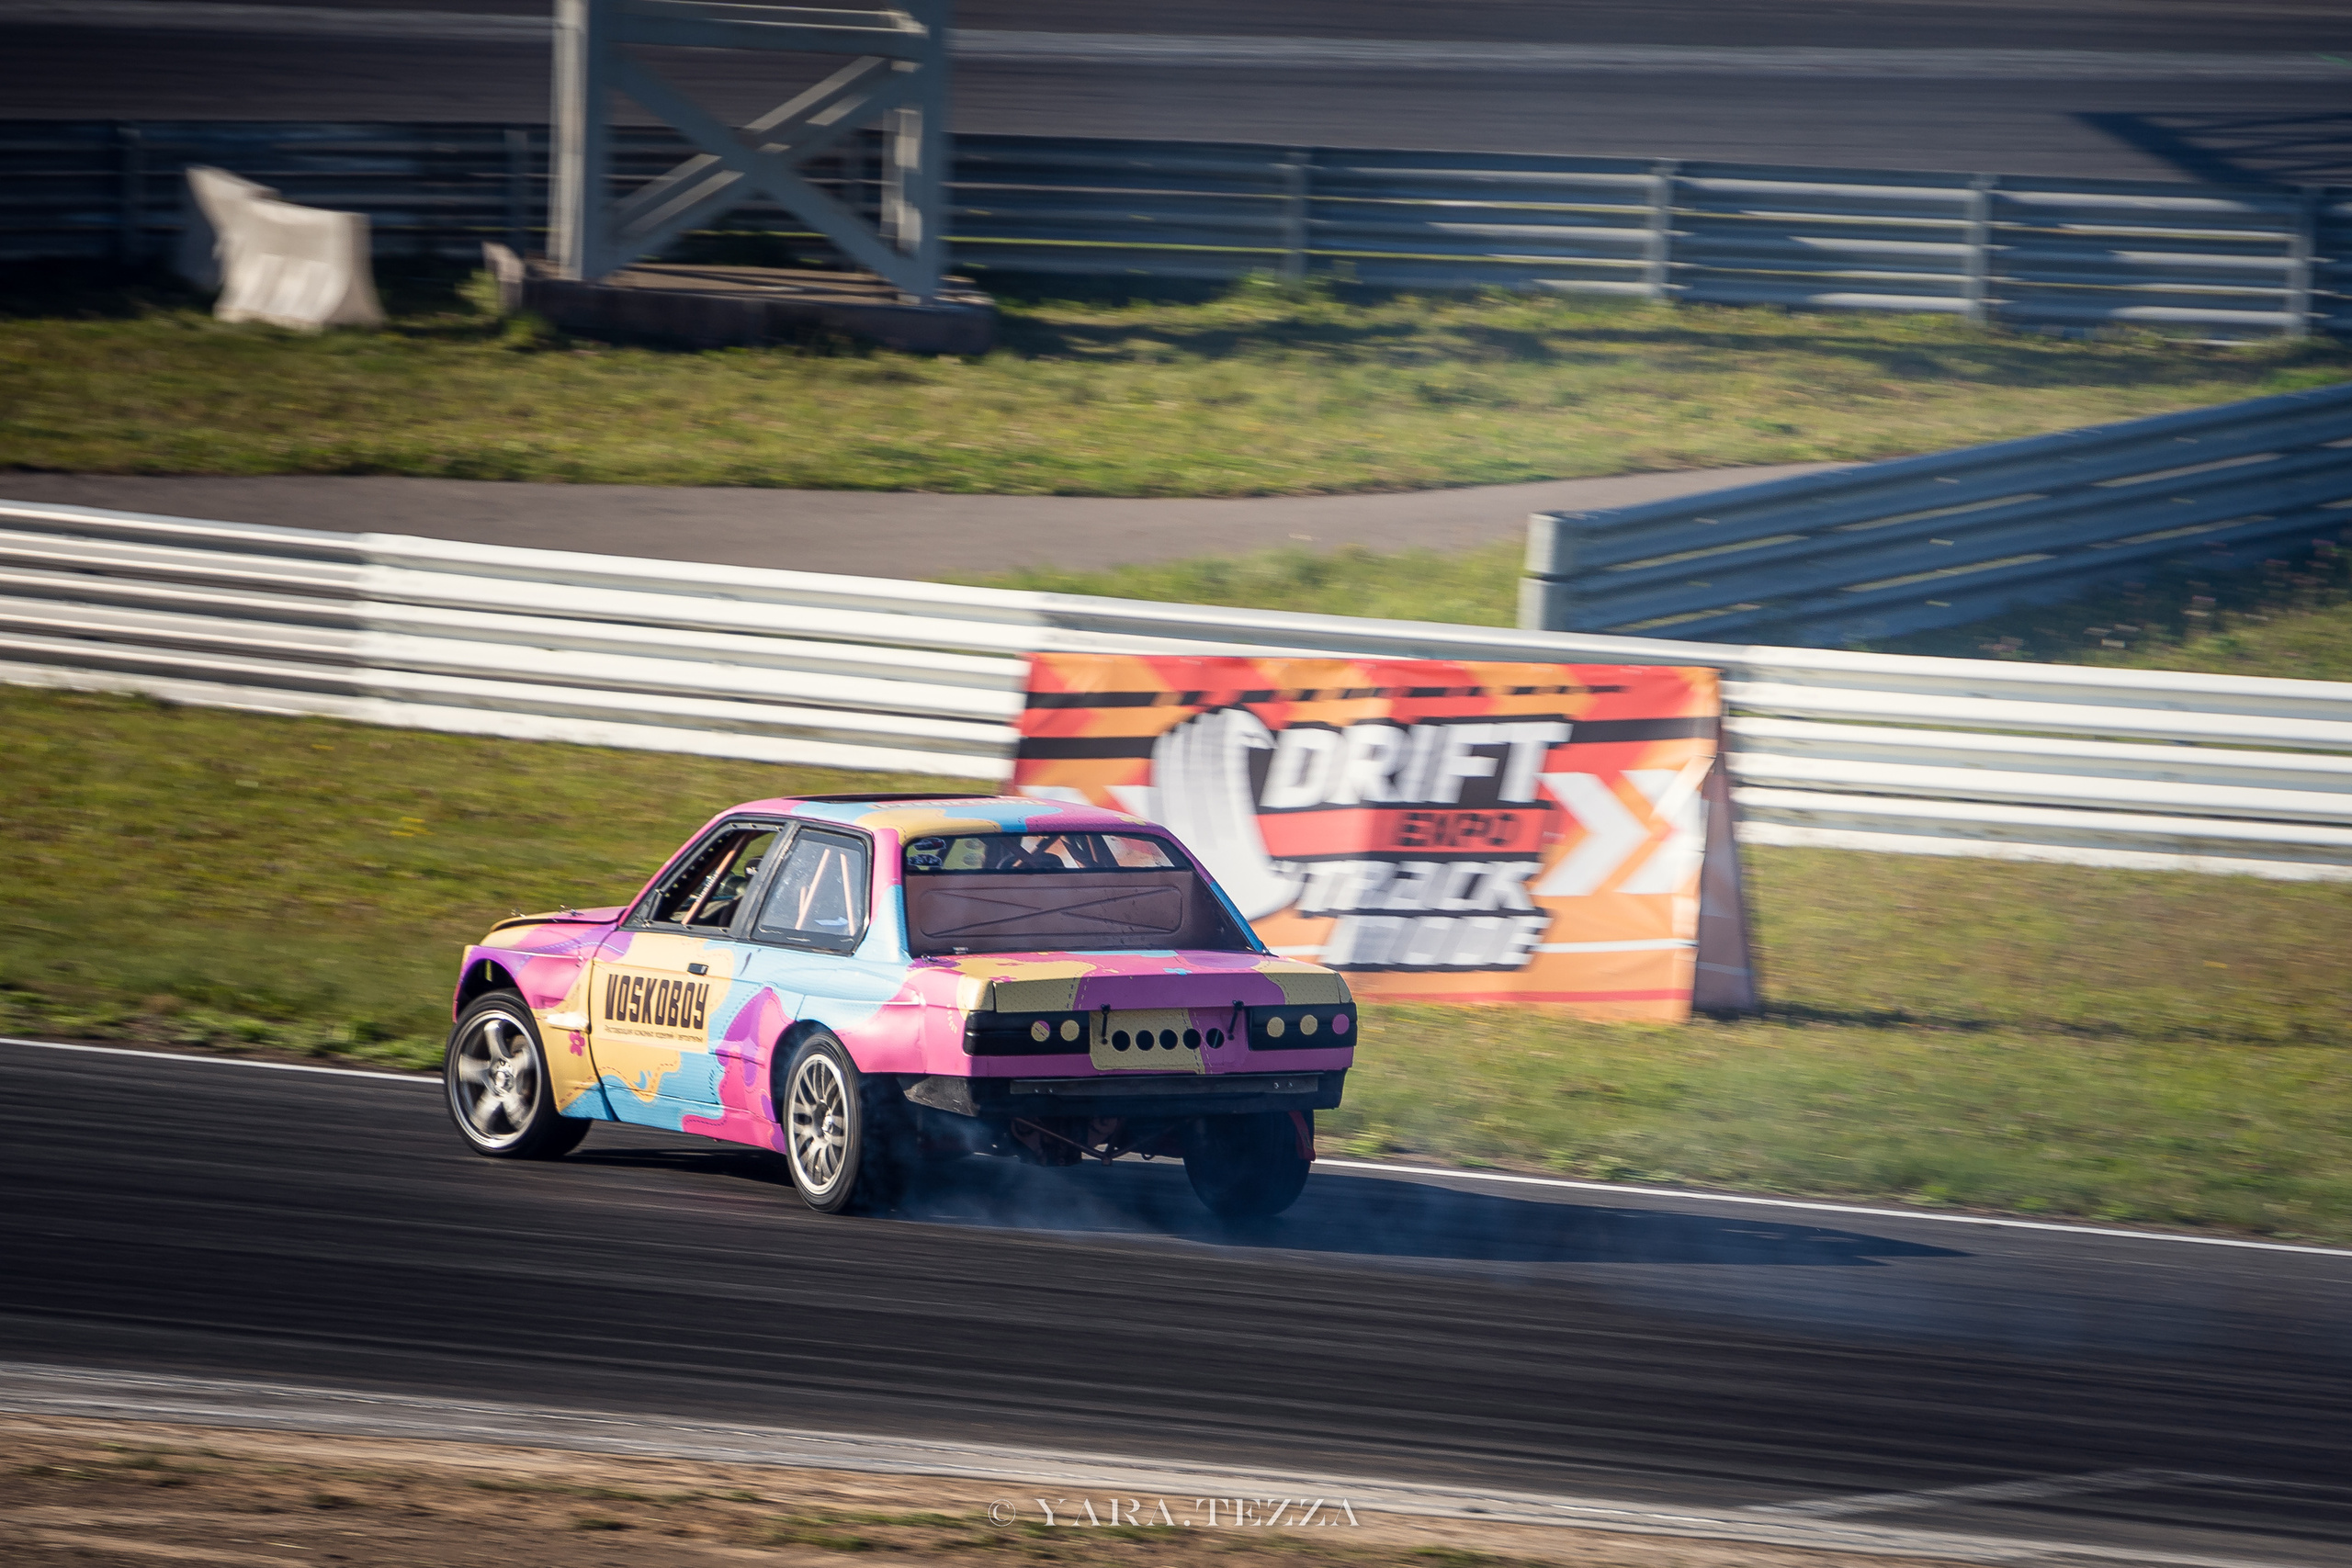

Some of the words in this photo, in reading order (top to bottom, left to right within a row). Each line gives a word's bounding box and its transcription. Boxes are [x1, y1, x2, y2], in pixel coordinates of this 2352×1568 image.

[1260, 722, 1573, 808] DRIFT
[1395, 812, 1521, 847] EXPO
[1283, 861, 1544, 911] TRACK
[605, 974, 710, 1030] VOSKOBOY
